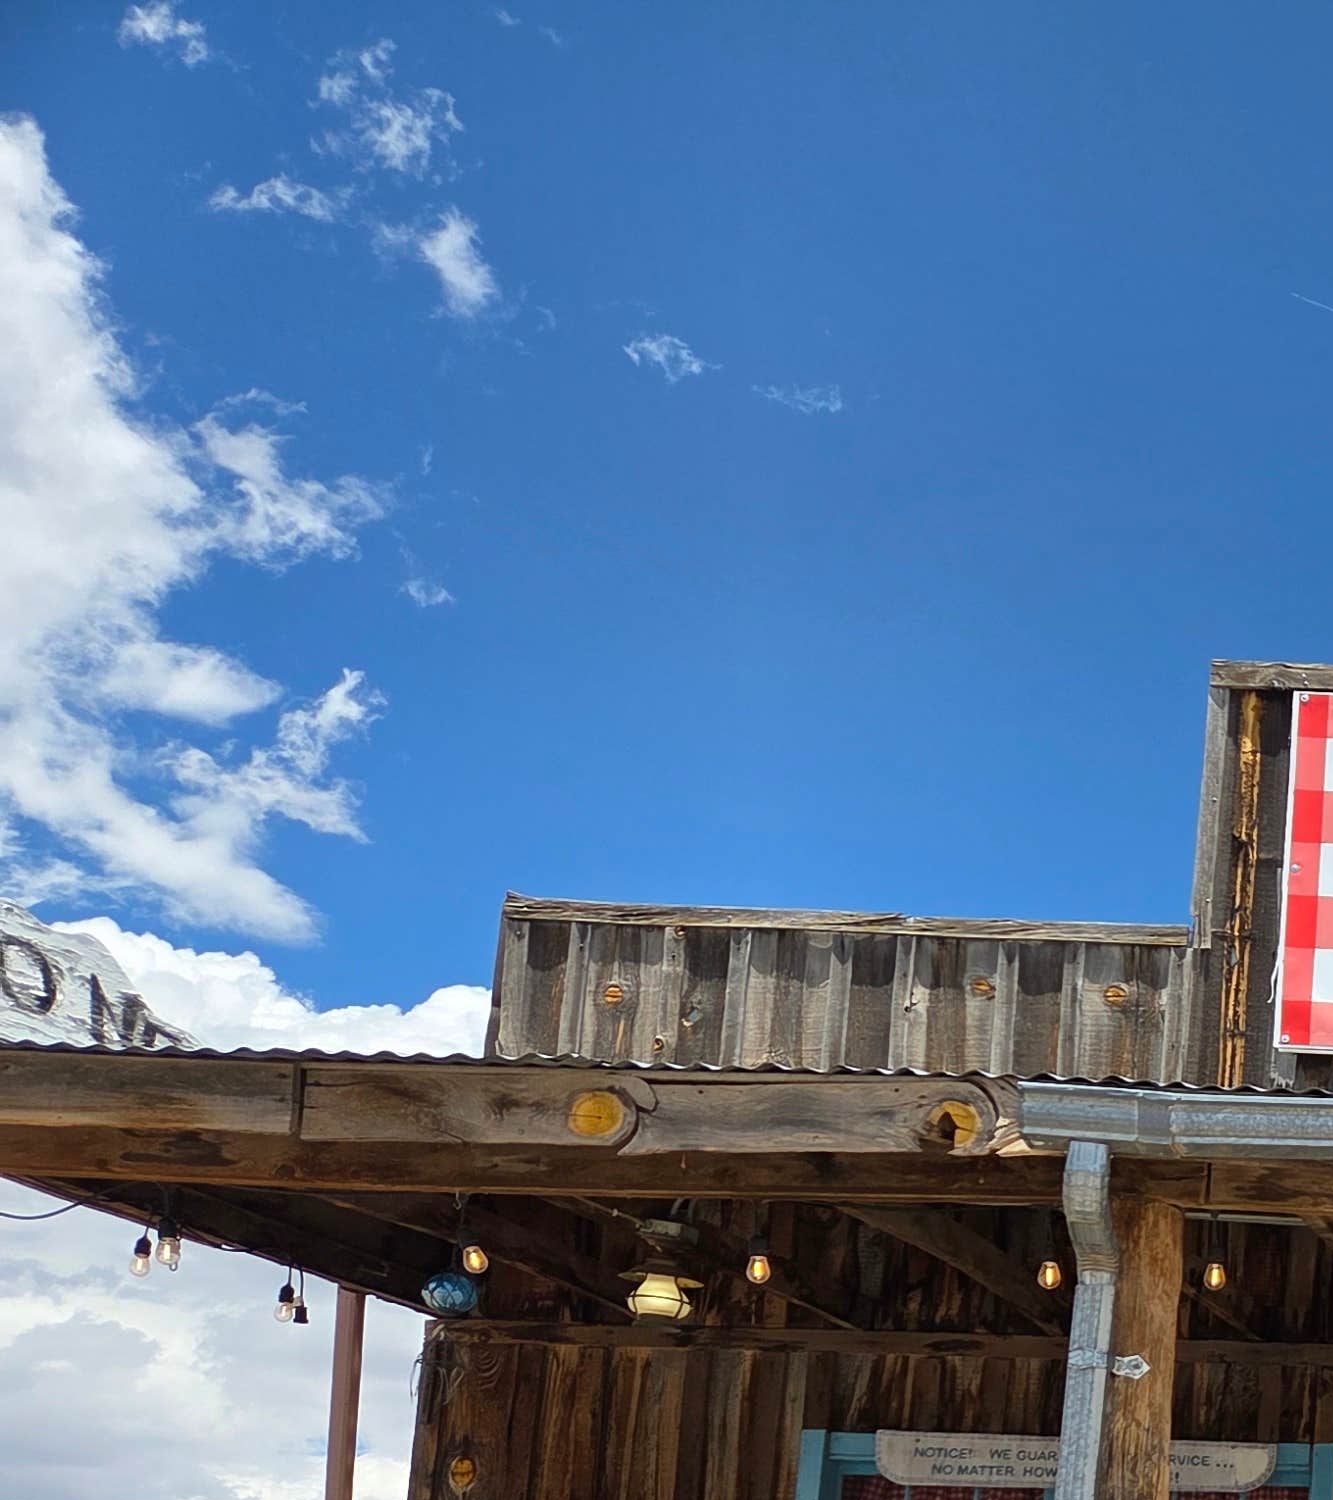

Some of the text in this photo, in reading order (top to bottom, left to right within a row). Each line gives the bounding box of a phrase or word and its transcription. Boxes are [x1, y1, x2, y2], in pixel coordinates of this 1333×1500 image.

[914, 1447, 973, 1459] NOTICE!
[990, 1449, 1012, 1460] WE
[1016, 1450, 1059, 1461] GUAR
[931, 1464, 1058, 1477] NO MATTER HOW
